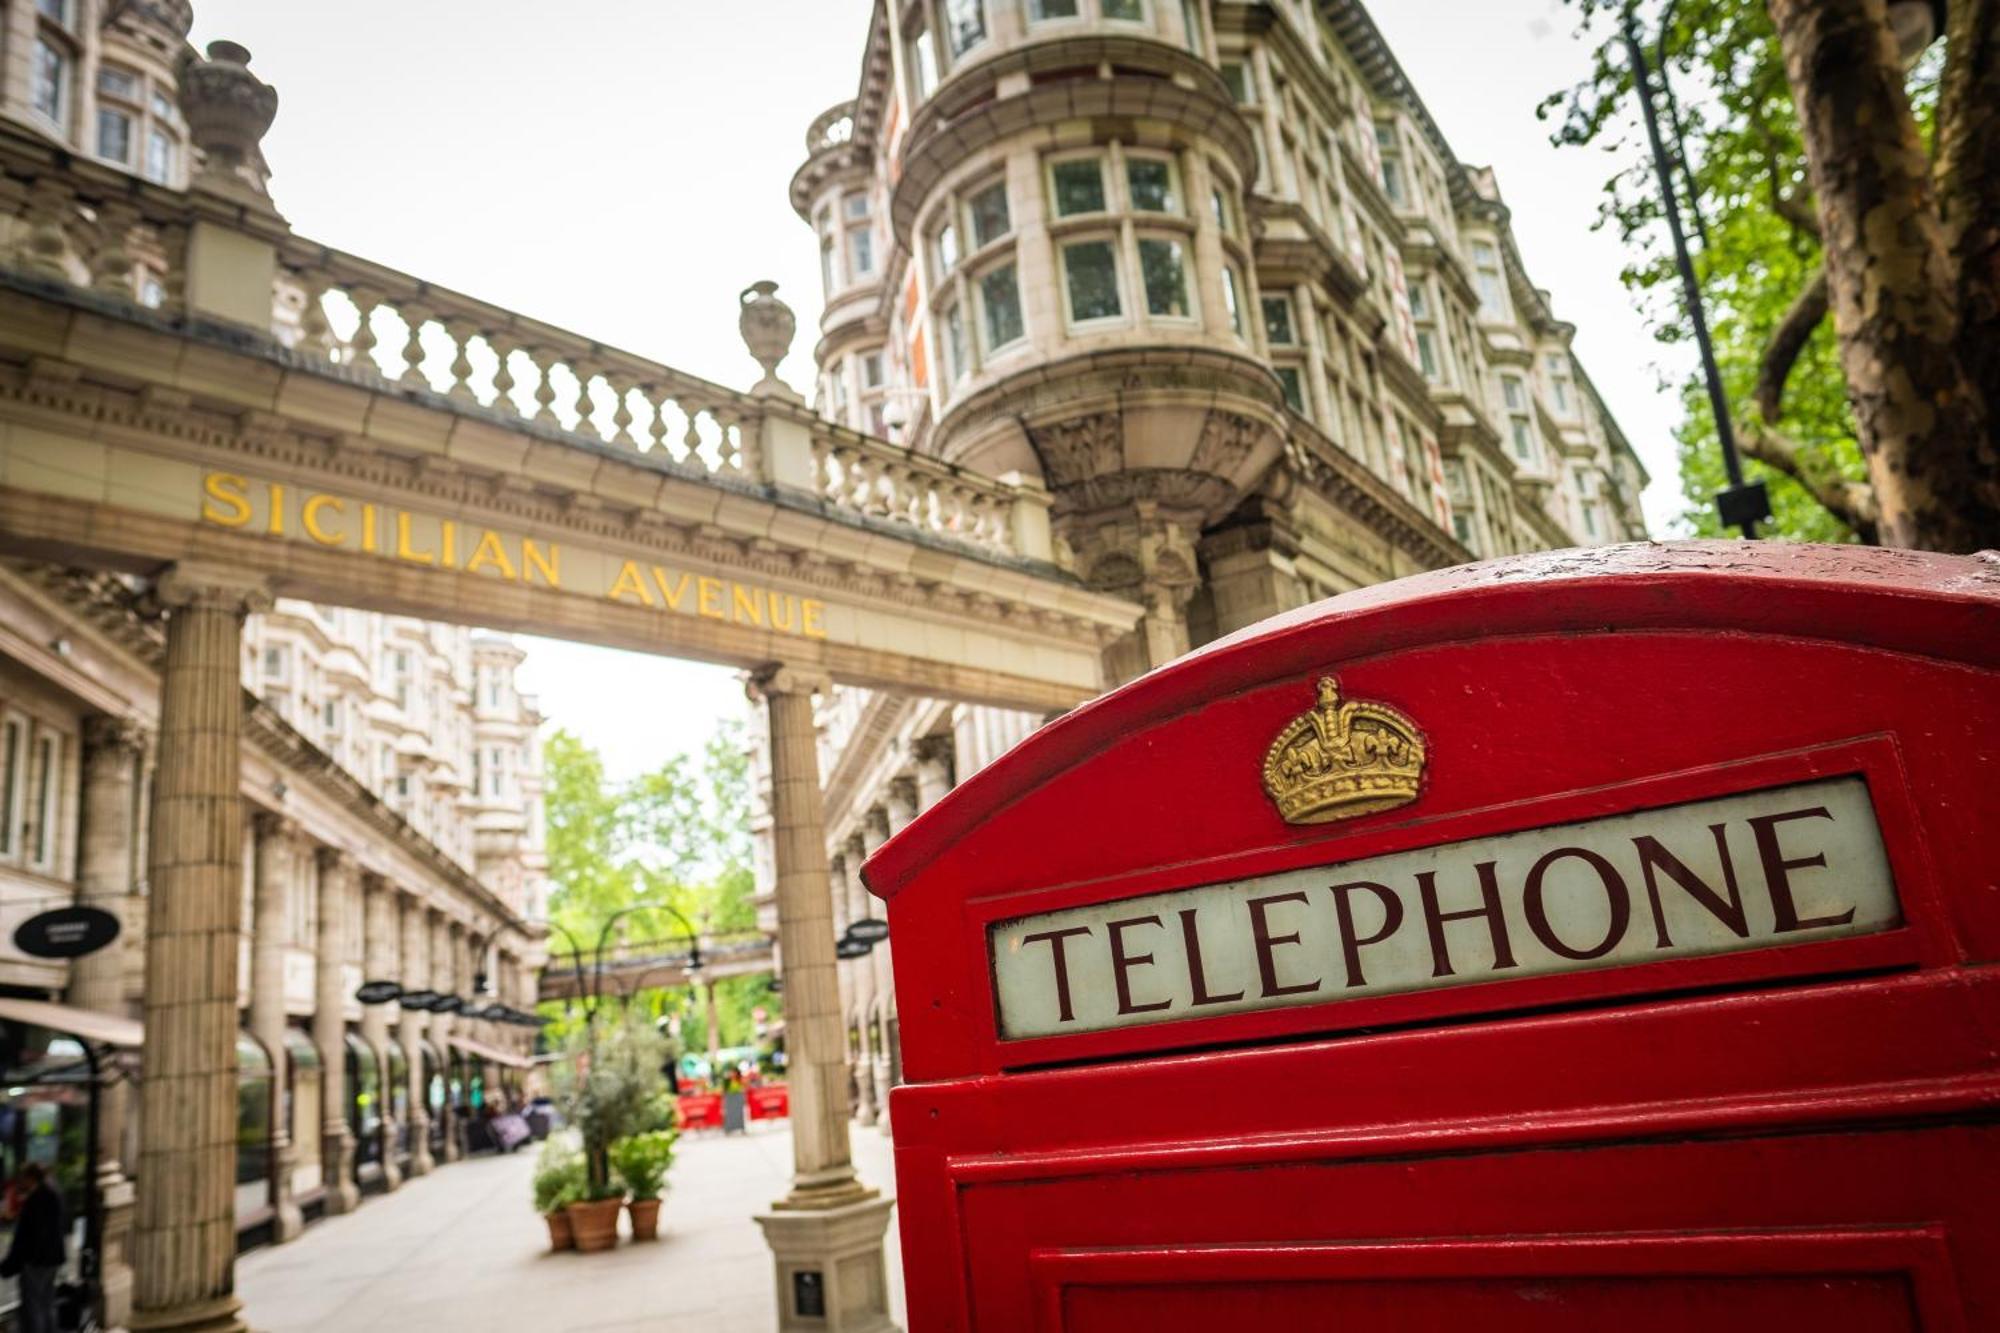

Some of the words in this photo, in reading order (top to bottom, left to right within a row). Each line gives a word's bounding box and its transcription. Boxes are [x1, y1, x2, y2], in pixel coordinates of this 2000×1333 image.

[202, 471, 561, 589] SICILIAN
[607, 559, 829, 639] AVENUE
[1022, 805, 1857, 1021] TELEPHONE
